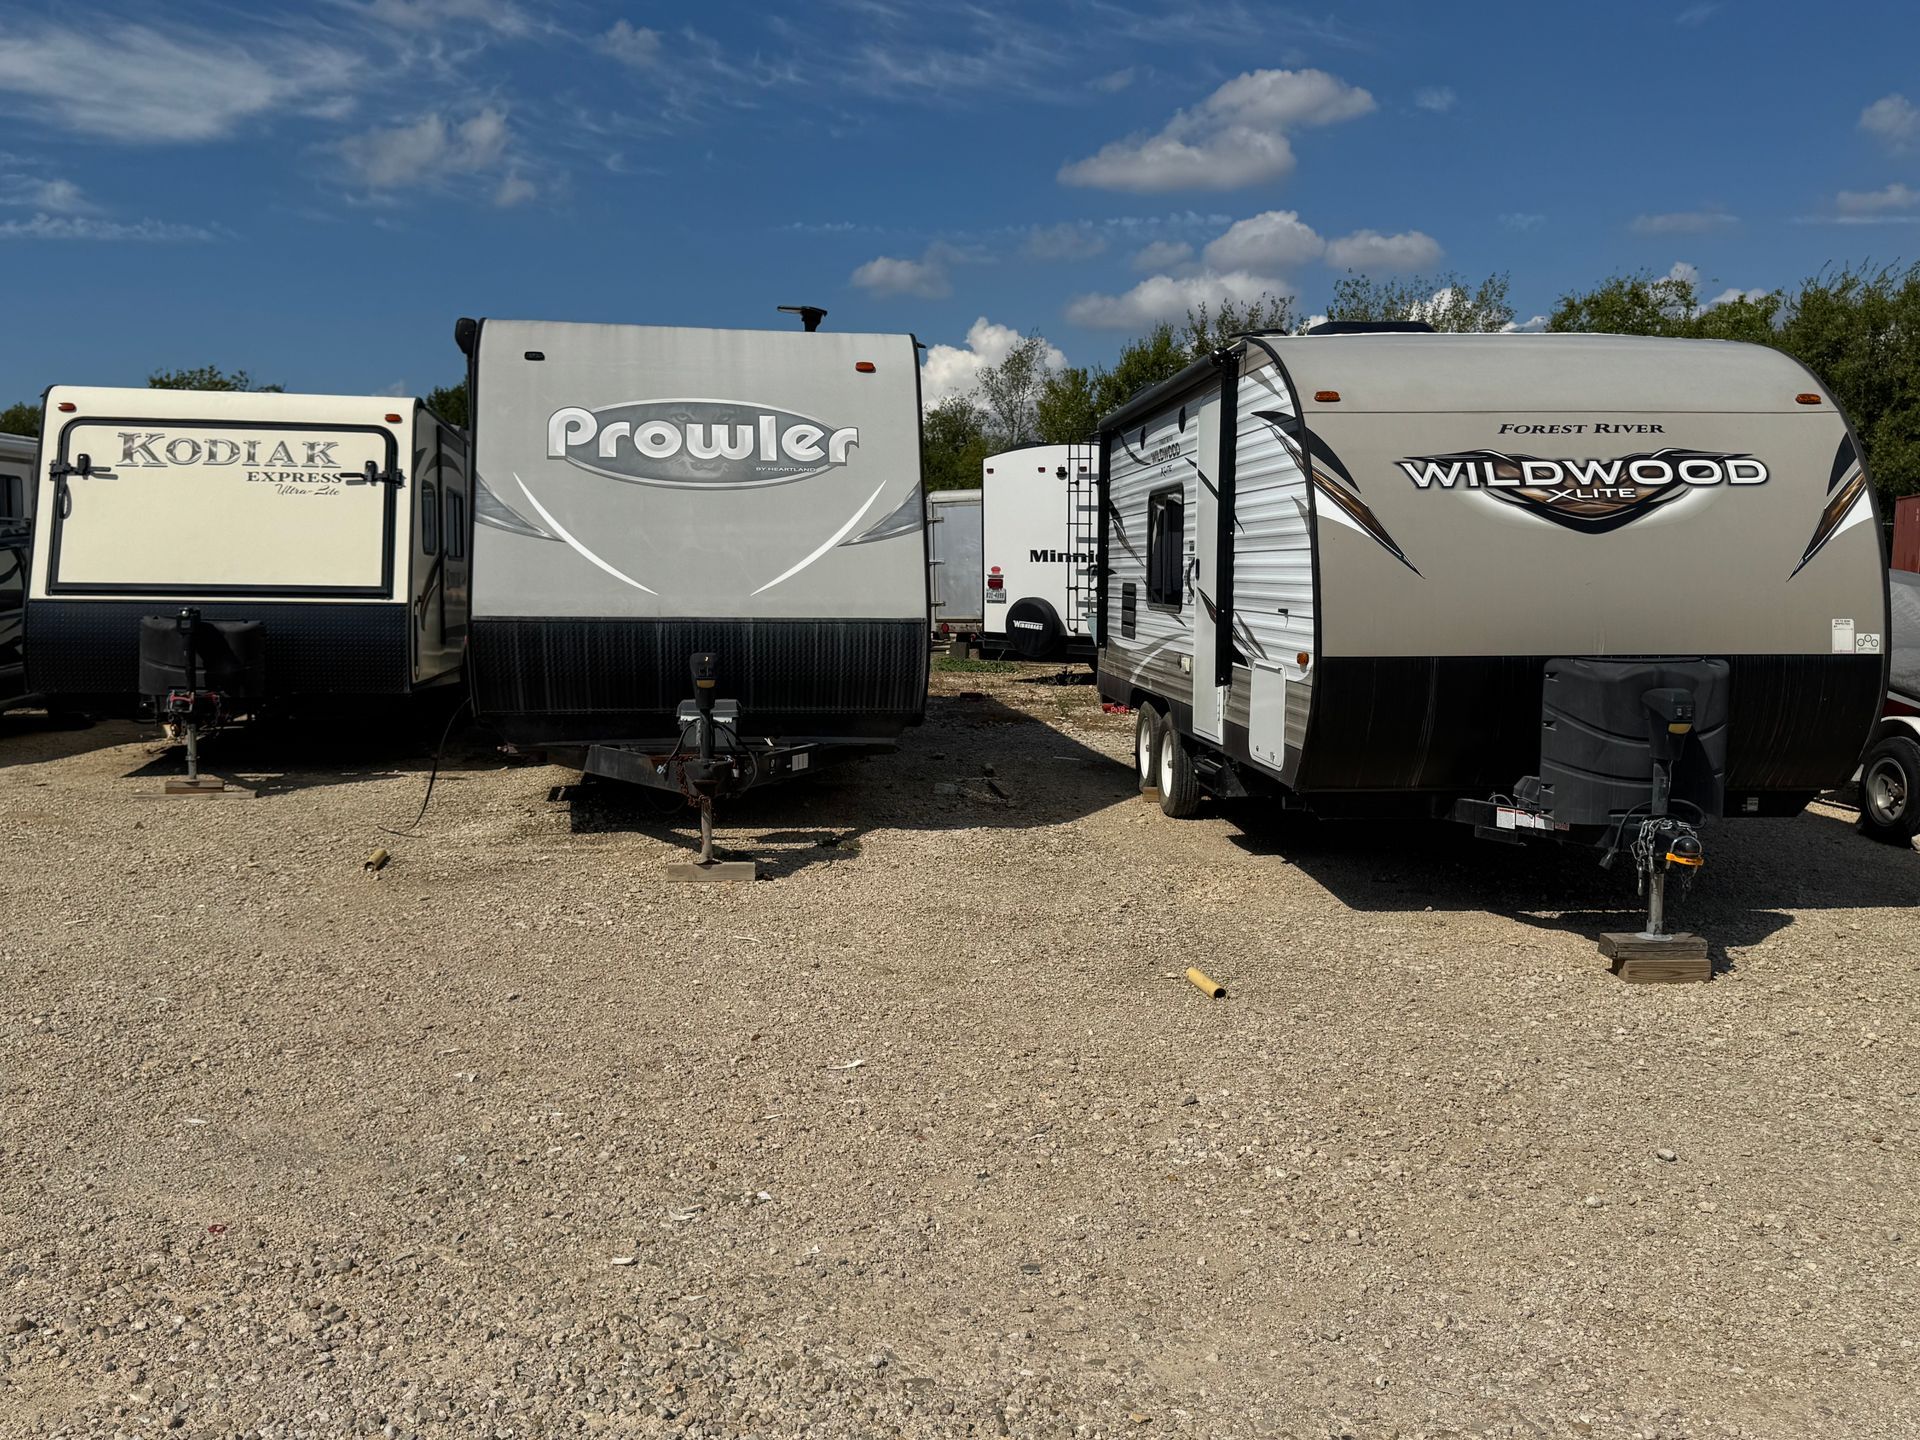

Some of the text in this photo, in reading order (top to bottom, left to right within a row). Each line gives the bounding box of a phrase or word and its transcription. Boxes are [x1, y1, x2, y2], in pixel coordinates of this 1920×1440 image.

[547, 406, 859, 466] Prowler
[1498, 423, 1665, 435] FOREST RIVER
[115, 432, 342, 468] KODIAK
[247, 471, 342, 483] EXPRESS
[1396, 458, 1769, 488] WILDWOOD
[1547, 488, 1636, 502] XLITE
